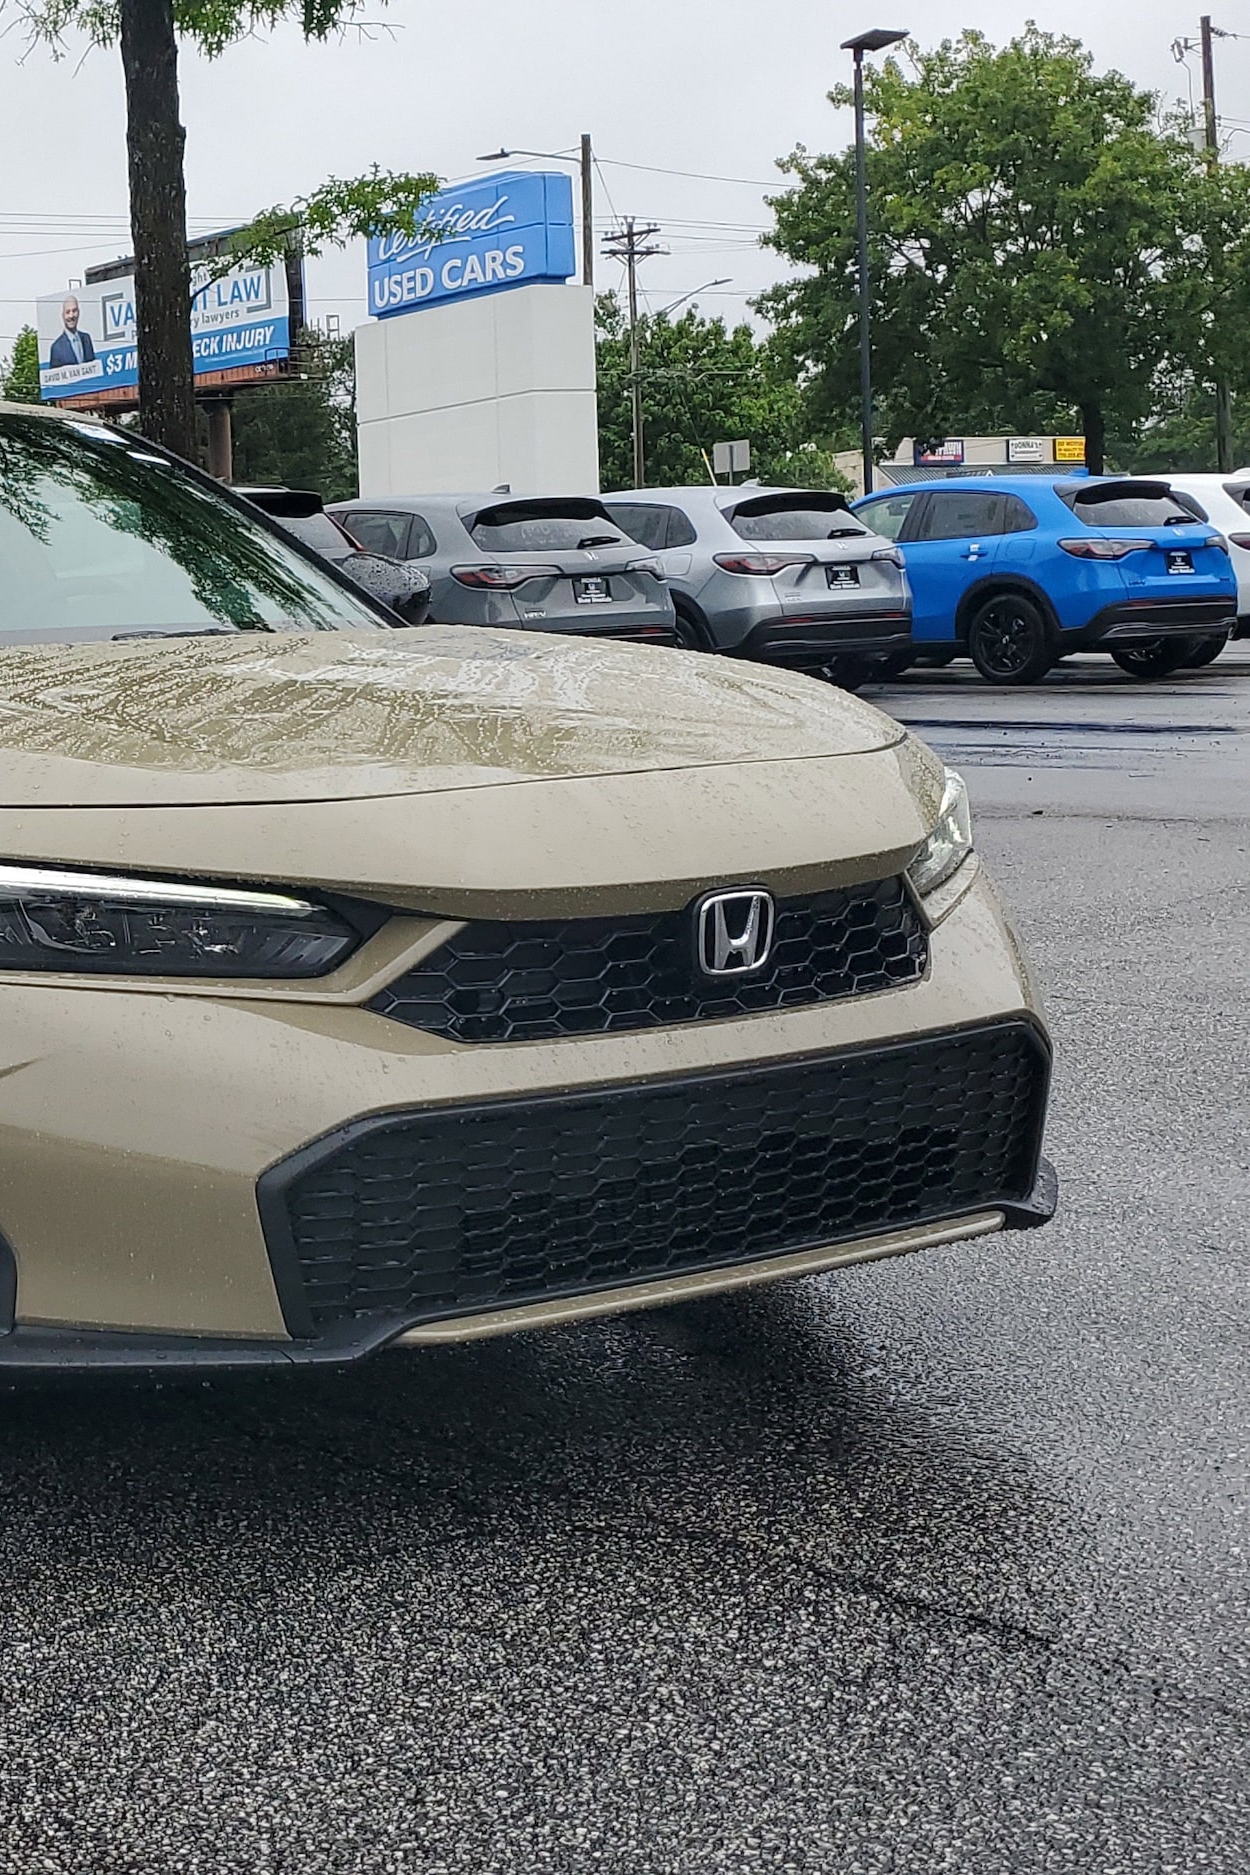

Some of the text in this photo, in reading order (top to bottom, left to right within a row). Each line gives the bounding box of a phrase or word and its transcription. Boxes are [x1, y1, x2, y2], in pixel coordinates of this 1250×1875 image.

[216, 275, 262, 307] LAW
[374, 245, 525, 308] USED CARS
[201, 309, 240, 325] lawyers
[106, 353, 123, 376] $3
[192, 335, 221, 358] ECK
[221, 325, 275, 353] INJURY
